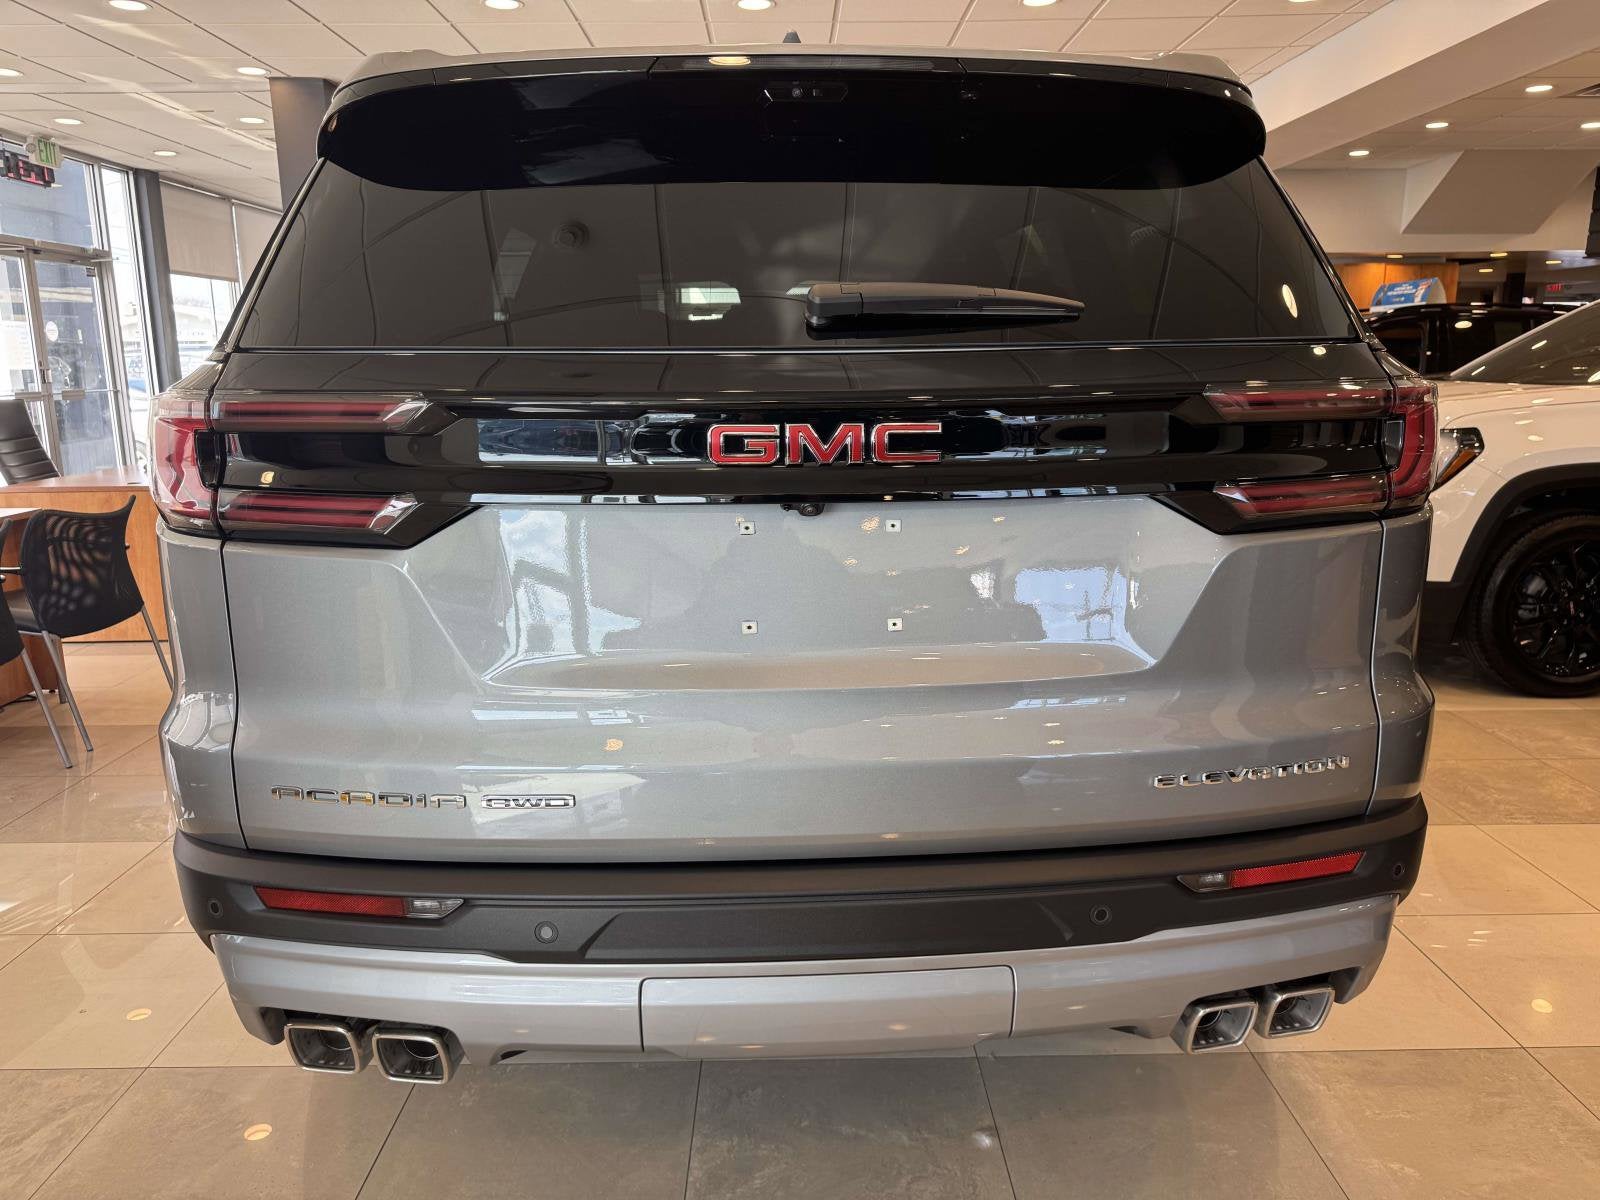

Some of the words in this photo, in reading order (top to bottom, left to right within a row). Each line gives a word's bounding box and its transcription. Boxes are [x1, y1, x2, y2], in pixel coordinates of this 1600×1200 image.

[38, 138, 58, 166] EXIT
[707, 422, 943, 467] GMC
[1153, 755, 1350, 789] ELEVATION
[271, 784, 467, 809] ACADIA
[483, 796, 573, 808] AWD
